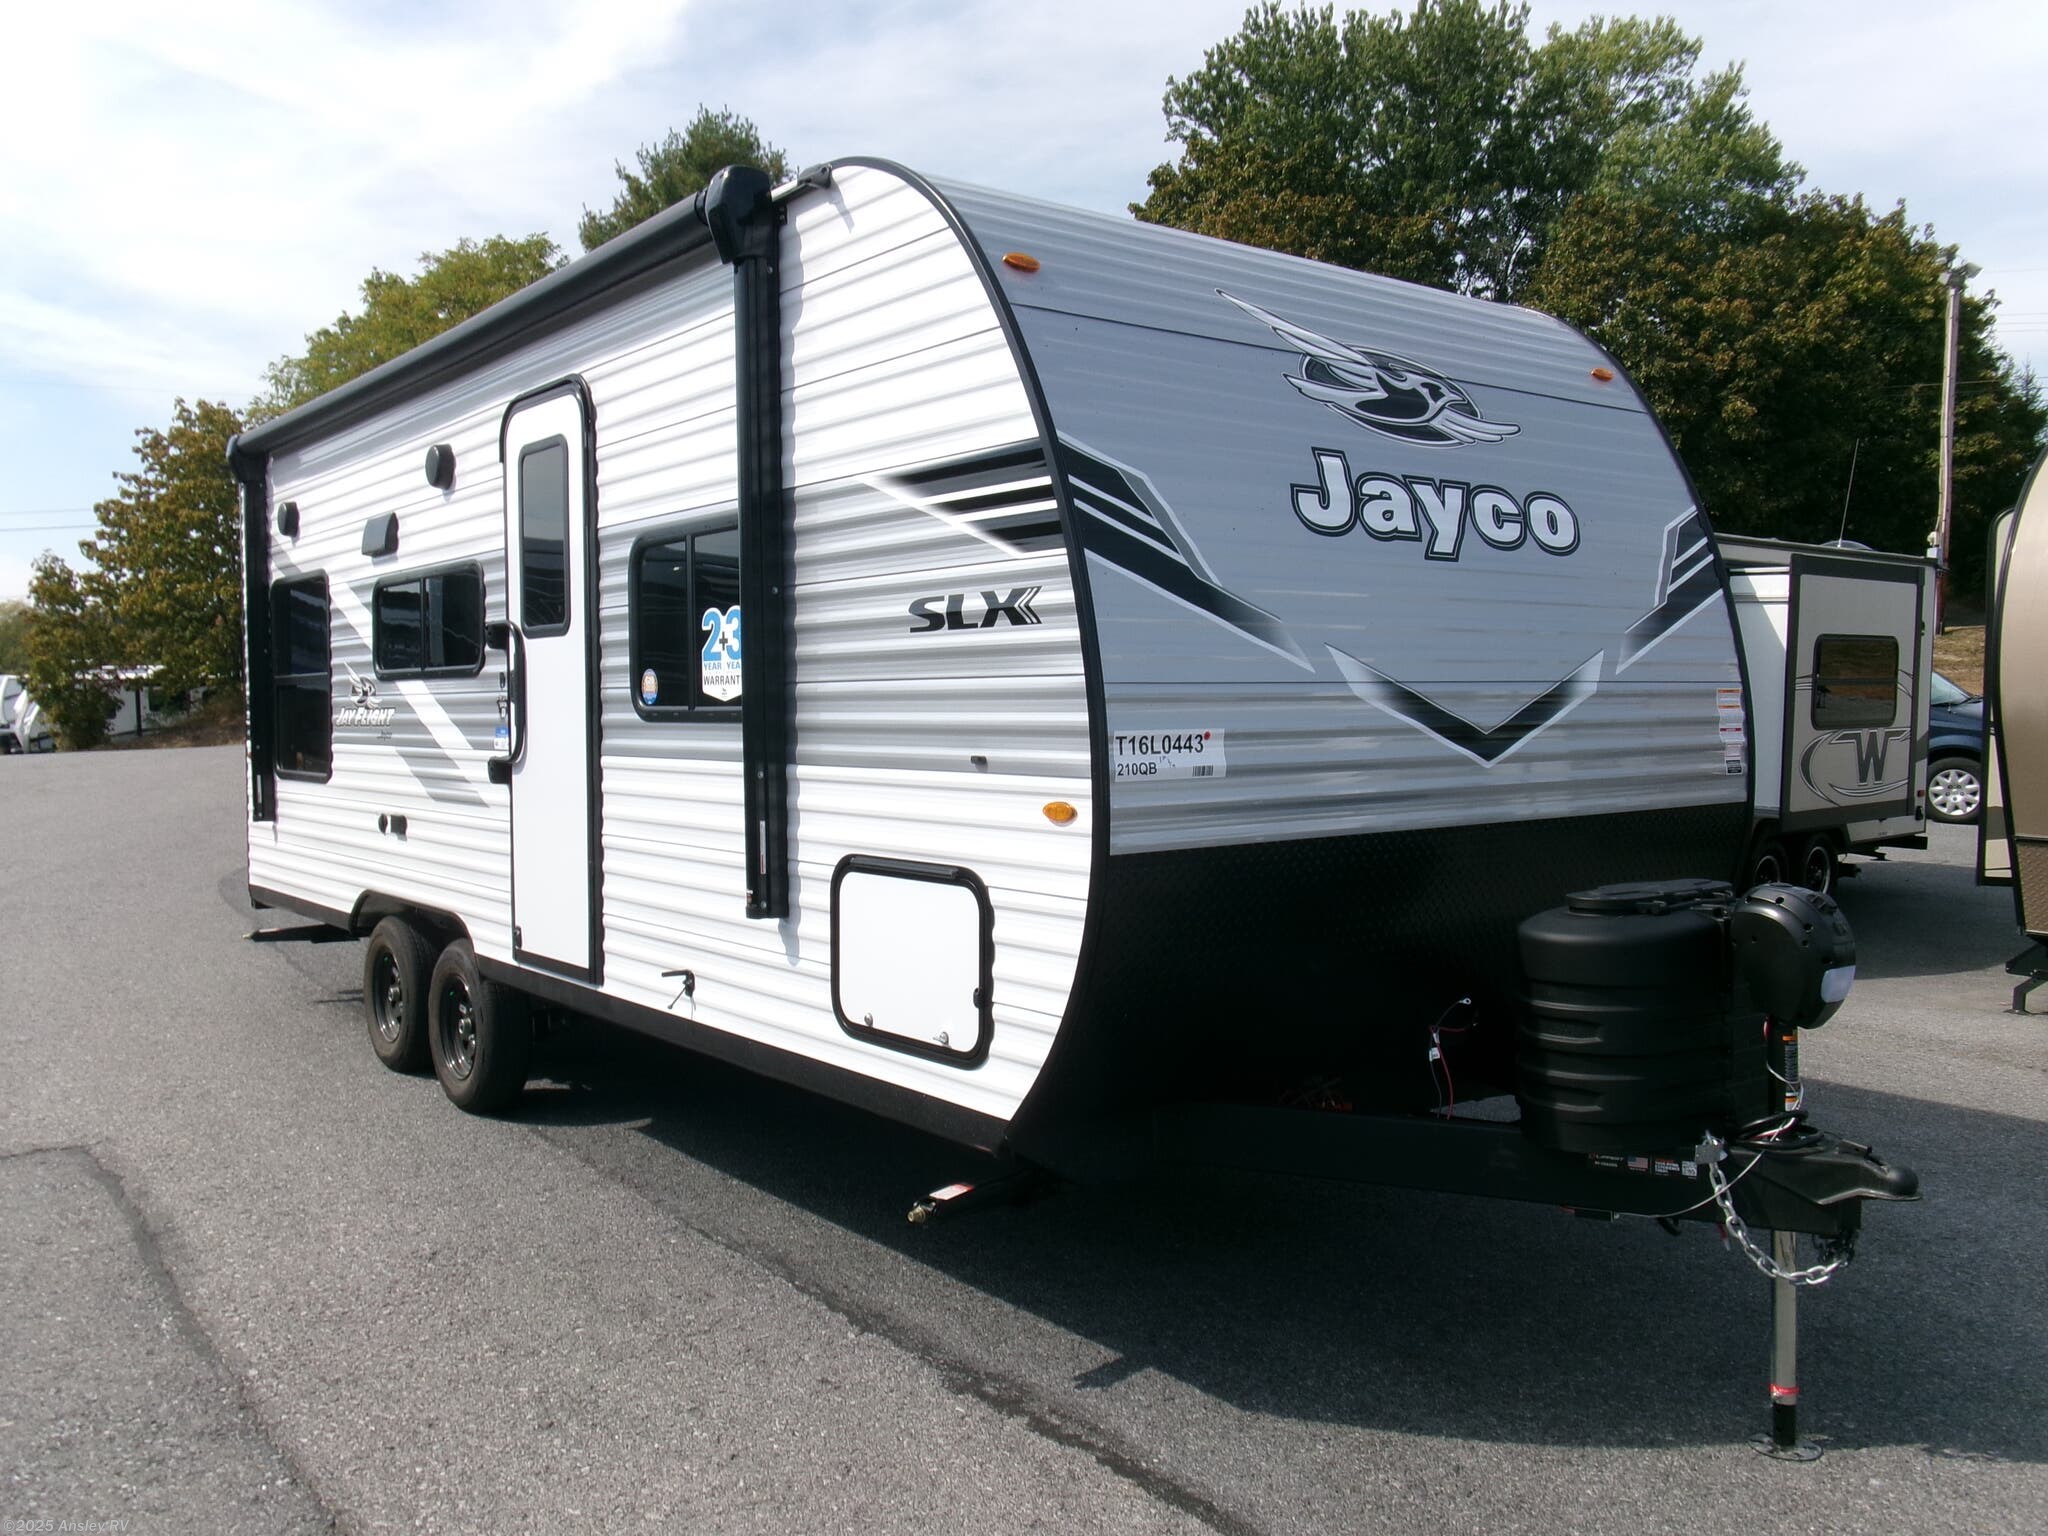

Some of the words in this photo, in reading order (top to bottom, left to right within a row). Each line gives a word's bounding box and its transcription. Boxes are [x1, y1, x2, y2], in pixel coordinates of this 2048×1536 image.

[1290, 446, 1581, 562] Jayco
[909, 585, 1043, 633] SLX
[703, 661, 722, 671] YEAR
[727, 661, 741, 670] YEA
[703, 674, 741, 686] WARRANT
[335, 707, 356, 727] JAY
[354, 706, 396, 727] FLIGHT
[1116, 734, 1204, 756] T16L0443
[1117, 762, 1158, 777] 210QB
